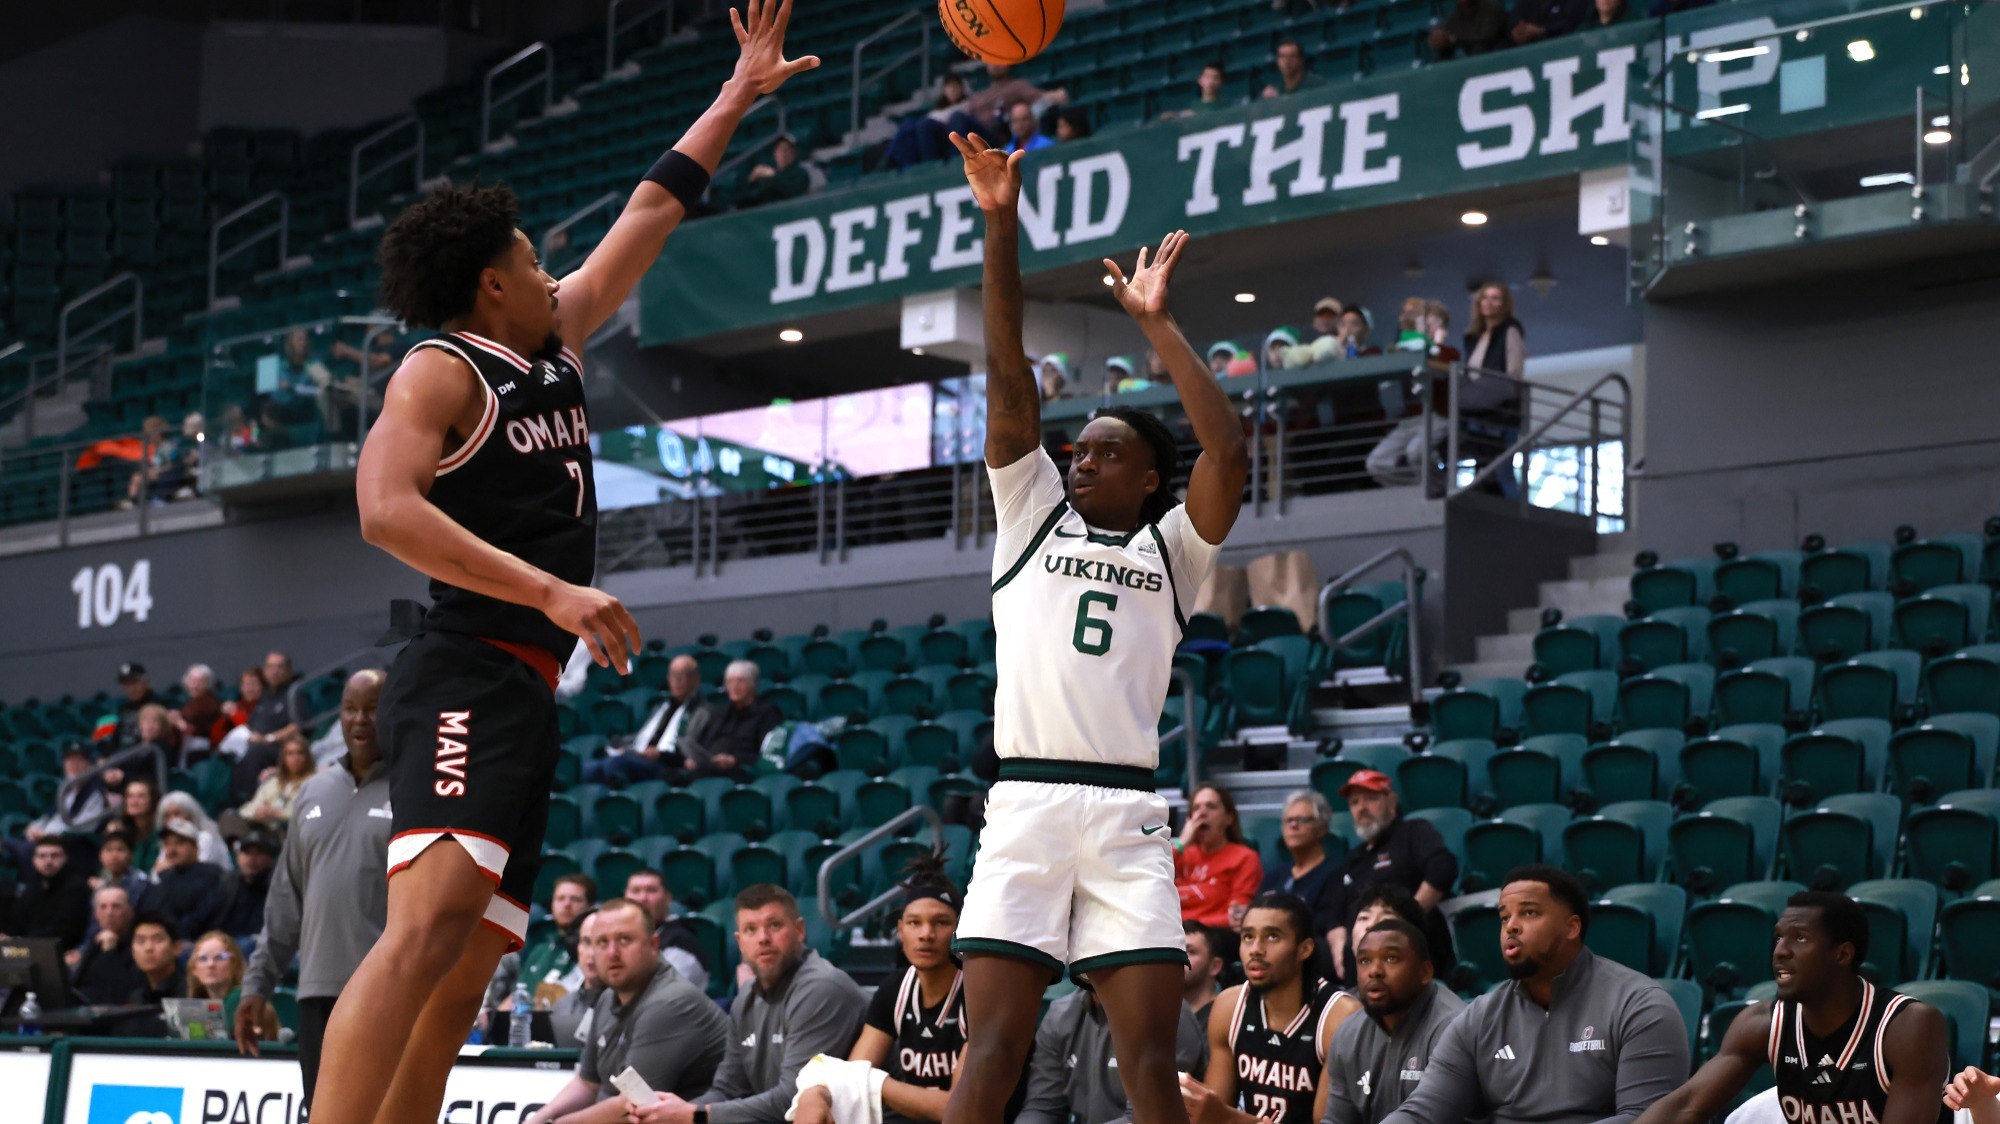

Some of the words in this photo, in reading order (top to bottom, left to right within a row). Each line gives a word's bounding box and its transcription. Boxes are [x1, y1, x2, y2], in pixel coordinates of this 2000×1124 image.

[954, 0, 991, 37] NCA
[1177, 92, 1401, 217] THE
[498, 381, 516, 395] DM
[506, 405, 589, 454] OMAH
[563, 459, 584, 519] 7
[71, 559, 153, 628] 104
[1045, 554, 1162, 592] VIKINGS
[1072, 590, 1118, 656] 6
[433, 709, 471, 797] MAVS
[1238, 1053, 1314, 1092] OMAHA
[1784, 1055, 1798, 1065] DM
[1781, 1095, 1881, 1124] OMAHA
